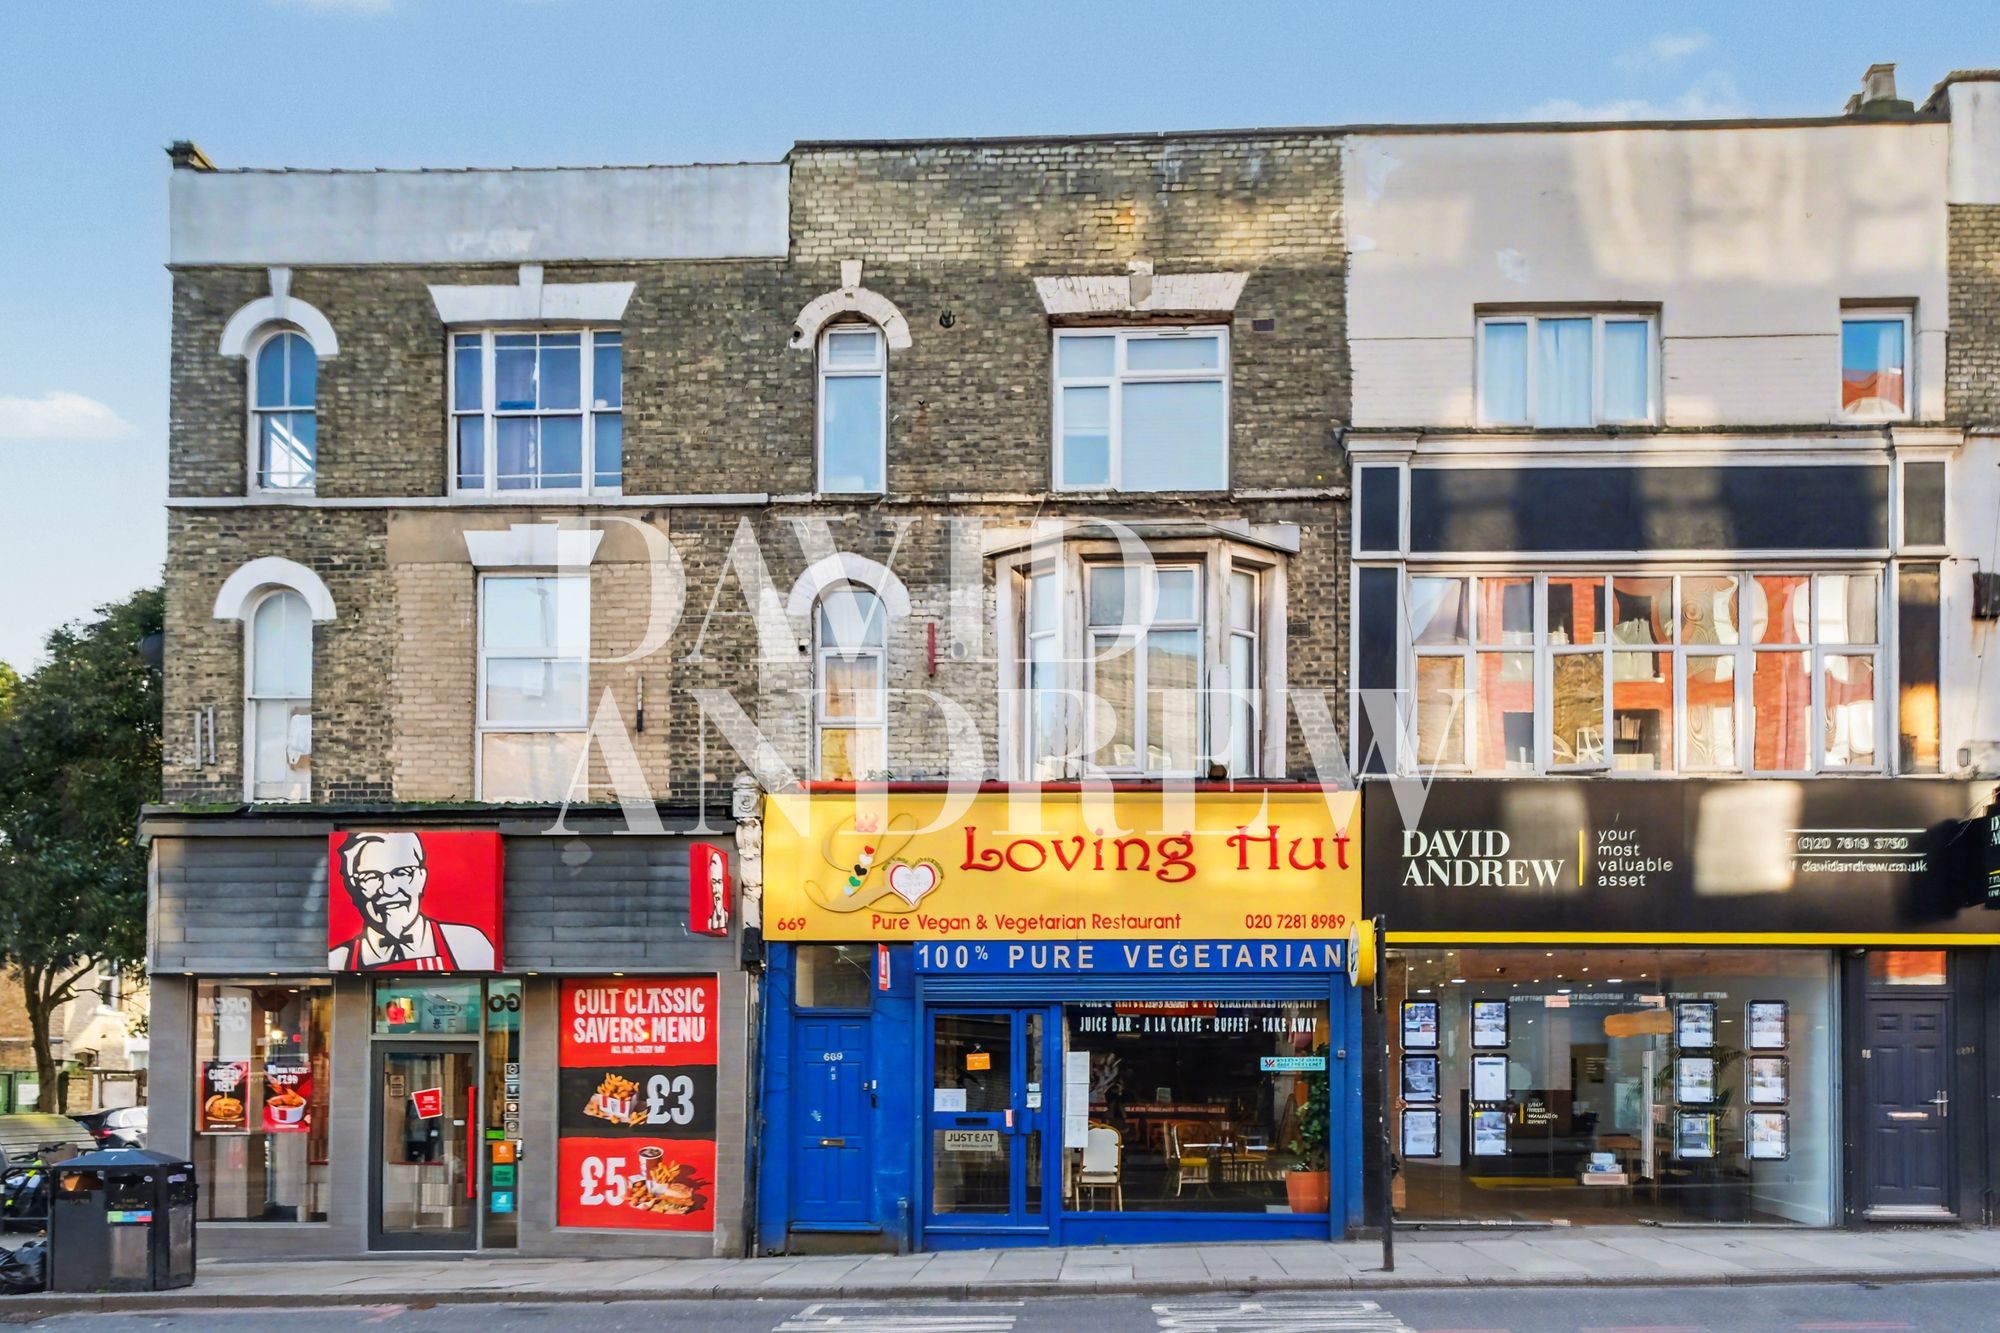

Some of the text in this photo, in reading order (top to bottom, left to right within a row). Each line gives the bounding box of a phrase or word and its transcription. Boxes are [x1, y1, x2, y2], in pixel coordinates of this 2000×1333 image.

[1402, 830, 1511, 858] DAVID
[1598, 829, 1636, 843] your
[960, 824, 1351, 883] Loving Hut
[1598, 843, 1640, 857] most
[1402, 859, 1565, 887] ANDREW
[1598, 857, 1674, 872] valuable
[1598, 873, 1647, 888] asset
[777, 917, 806, 931] 669
[872, 913, 1182, 934] Pure Vegan & Vegetarian Restaurant
[1245, 914, 1346, 930] 020 7281 8989
[919, 945, 989, 969] 100%
[1009, 945, 1094, 969] PURE
[1123, 944, 1342, 969] VEGETARIAN
[574, 987, 705, 1014] CULT CLASSIC
[573, 1016, 706, 1043] SAVERS MENU
[1080, 1017, 1317, 1032] JUICE BAR A LA CARTE BUFFET TAKE AWAY
[646, 1074, 695, 1126] £3
[947, 1133, 994, 1142] JUST EAT
[580, 1156, 626, 1206] £5
